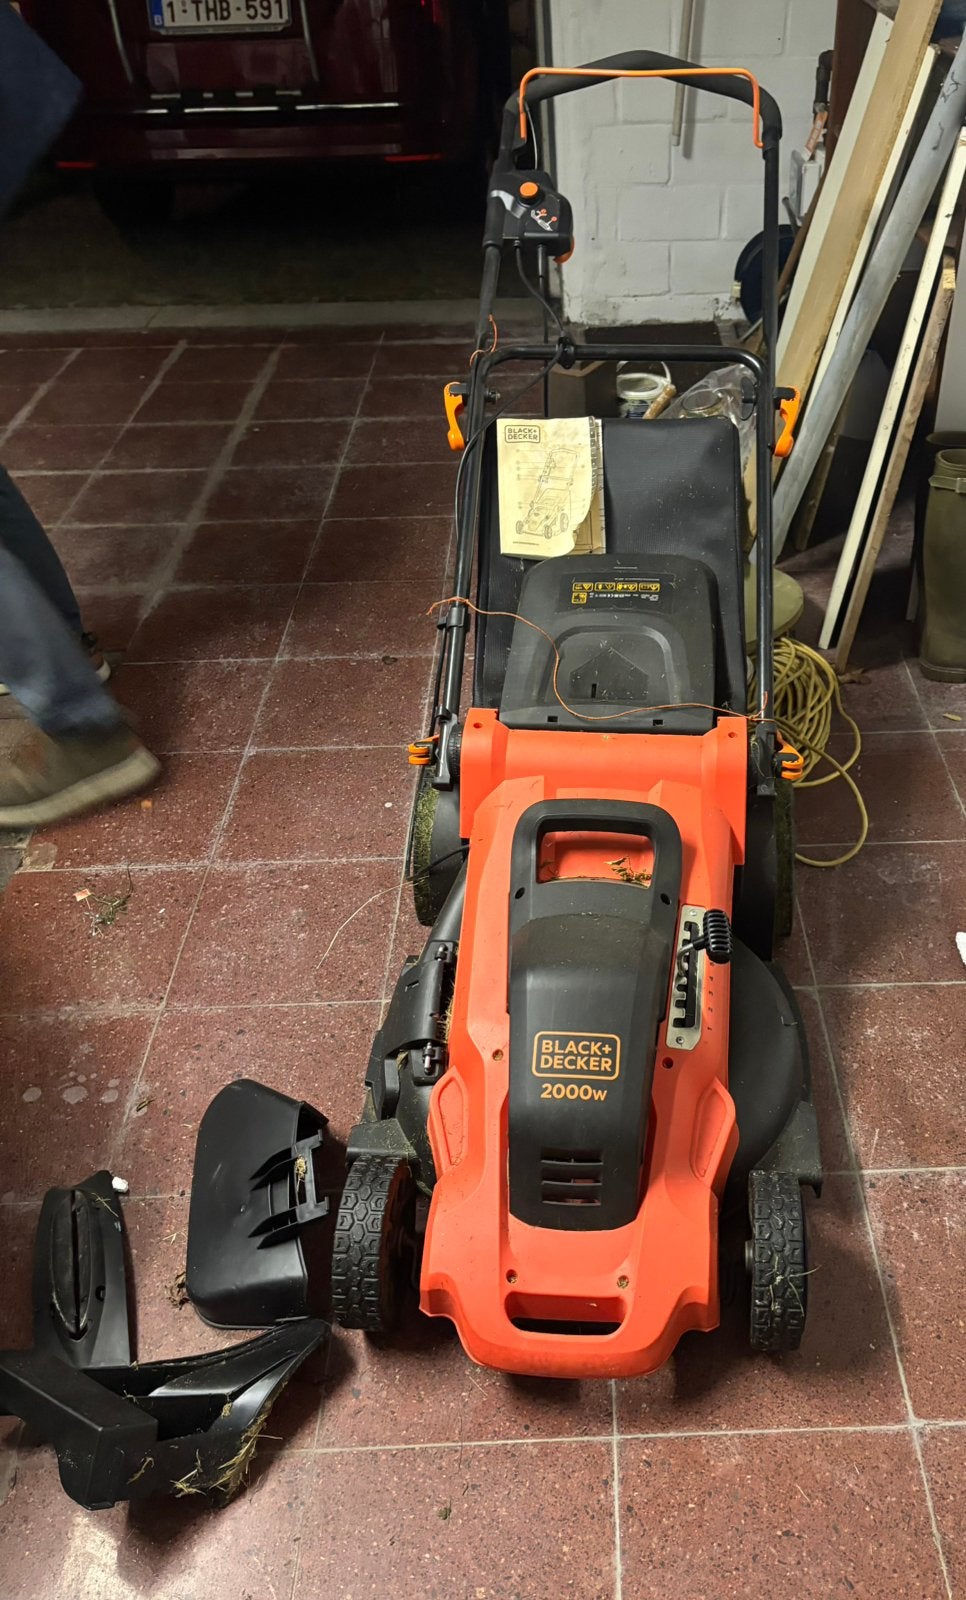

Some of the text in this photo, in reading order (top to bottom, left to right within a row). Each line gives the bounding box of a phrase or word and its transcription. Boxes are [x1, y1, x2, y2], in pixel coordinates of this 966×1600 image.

[154, 15, 163, 26] B
[507, 433, 539, 441] DECKER
[541, 1039, 612, 1056] BLACK+
[540, 1055, 612, 1072] DECKER
